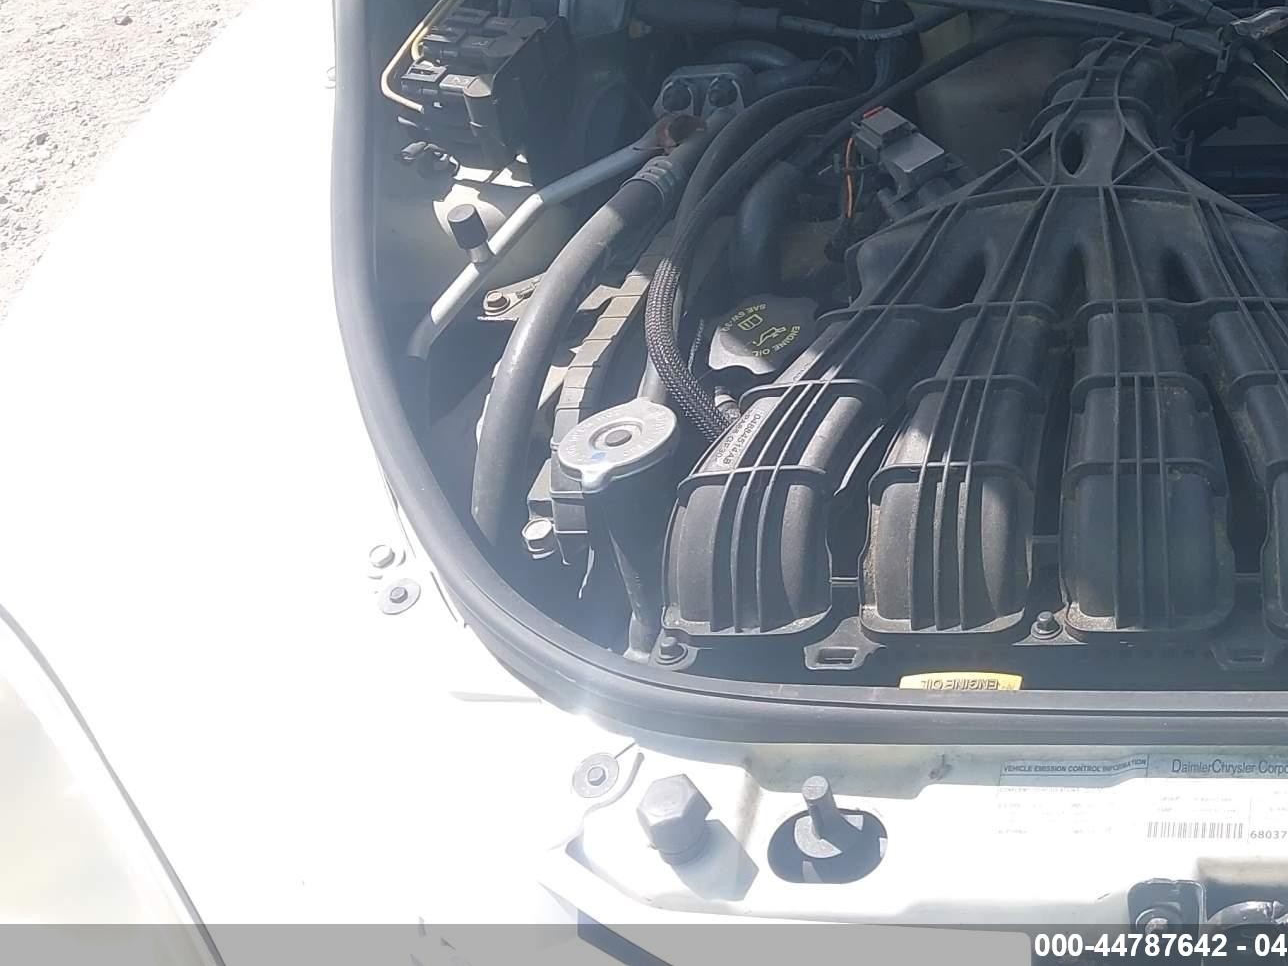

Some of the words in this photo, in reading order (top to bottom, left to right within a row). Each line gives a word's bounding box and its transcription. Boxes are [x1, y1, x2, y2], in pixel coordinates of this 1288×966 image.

[773, 325, 801, 352] ENGINE
[751, 348, 771, 358] OIL
[944, 678, 998, 690] ENGINE
[1003, 764, 1031, 772] VEHICLE
[1068, 765, 1101, 773] CONTROL
[1171, 759, 1257, 776] DaimlerChrysler
